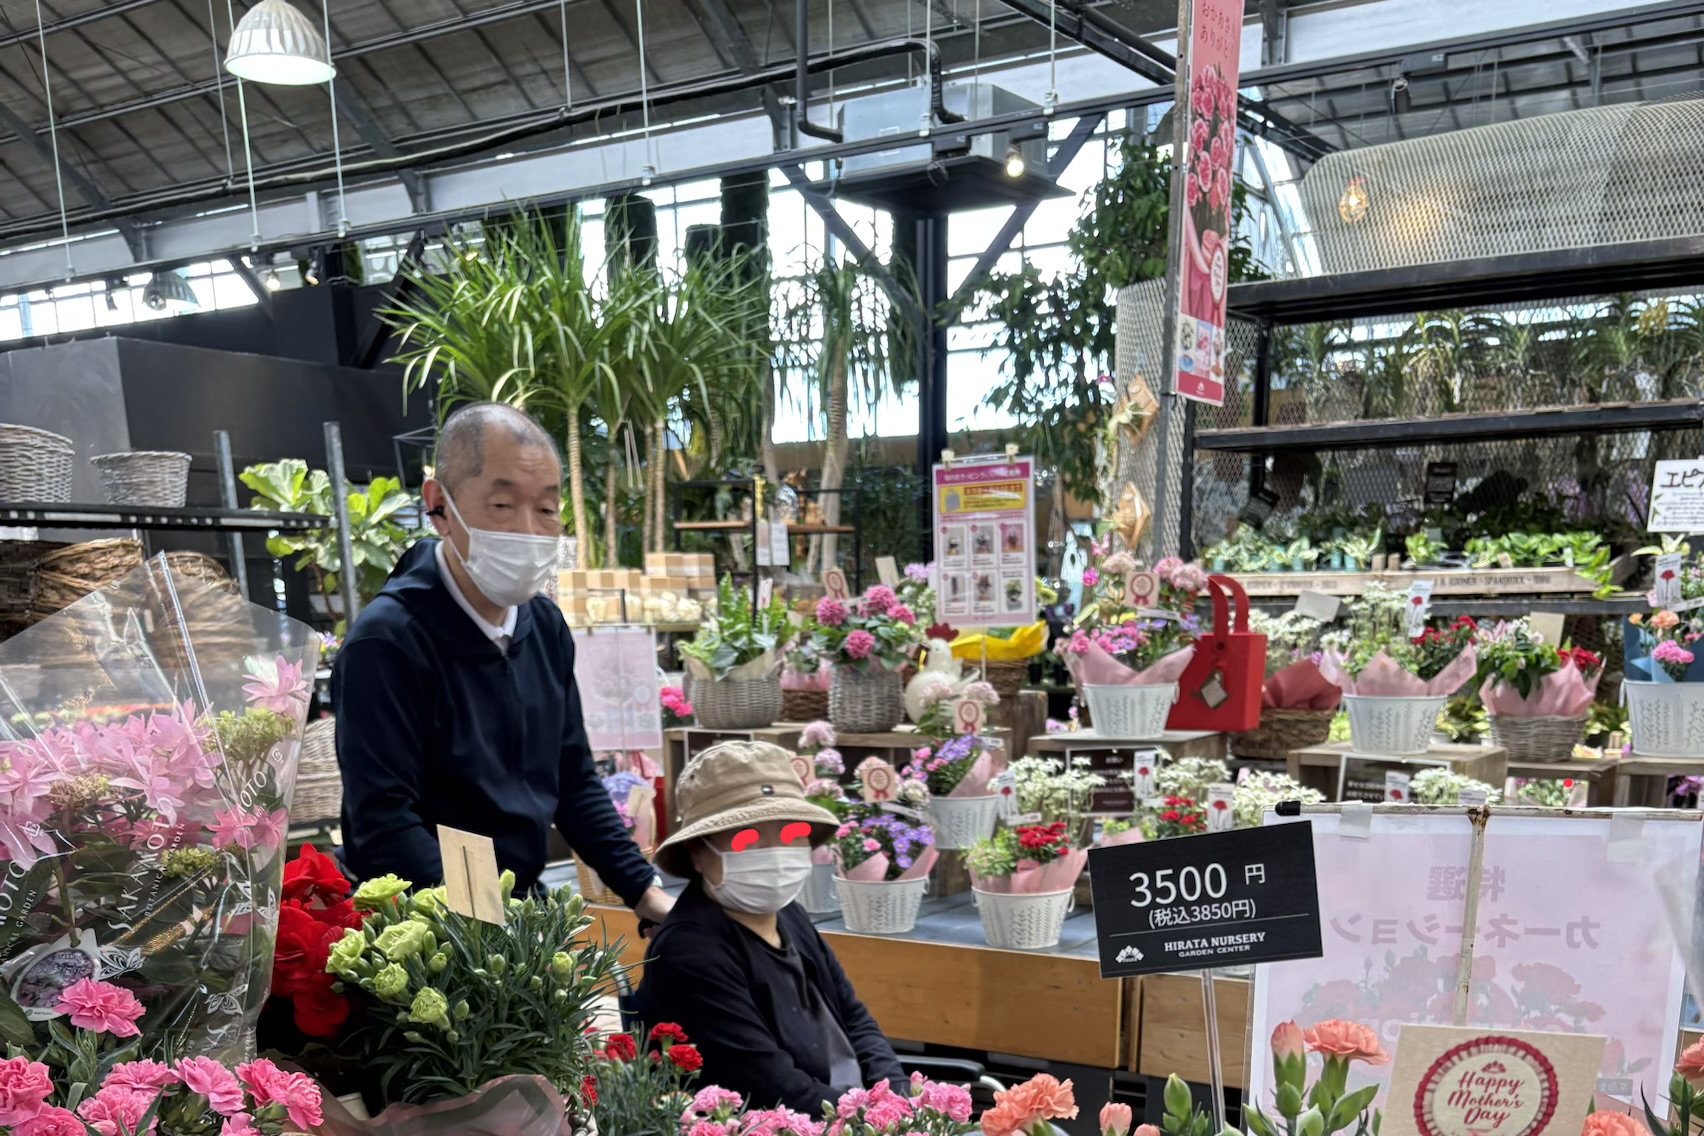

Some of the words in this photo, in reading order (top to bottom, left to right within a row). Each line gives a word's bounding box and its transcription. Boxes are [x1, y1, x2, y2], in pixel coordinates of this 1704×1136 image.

[1128, 862, 1227, 908] 3500
[1244, 863, 1267, 885] 円
[15, 889, 37, 928] GARDEN
[1148, 898, 1256, 930] (税込3850円)
[1164, 938, 1209, 952] HIRATA
[1211, 931, 1266, 947] NURSERY
[1178, 948, 1214, 958] GARDEN
[1216, 945, 1251, 955] CENTER
[1458, 1070, 1525, 1095] Happy
[1447, 1089, 1525, 1110] Mother's
[1464, 1106, 1511, 1129] Day
